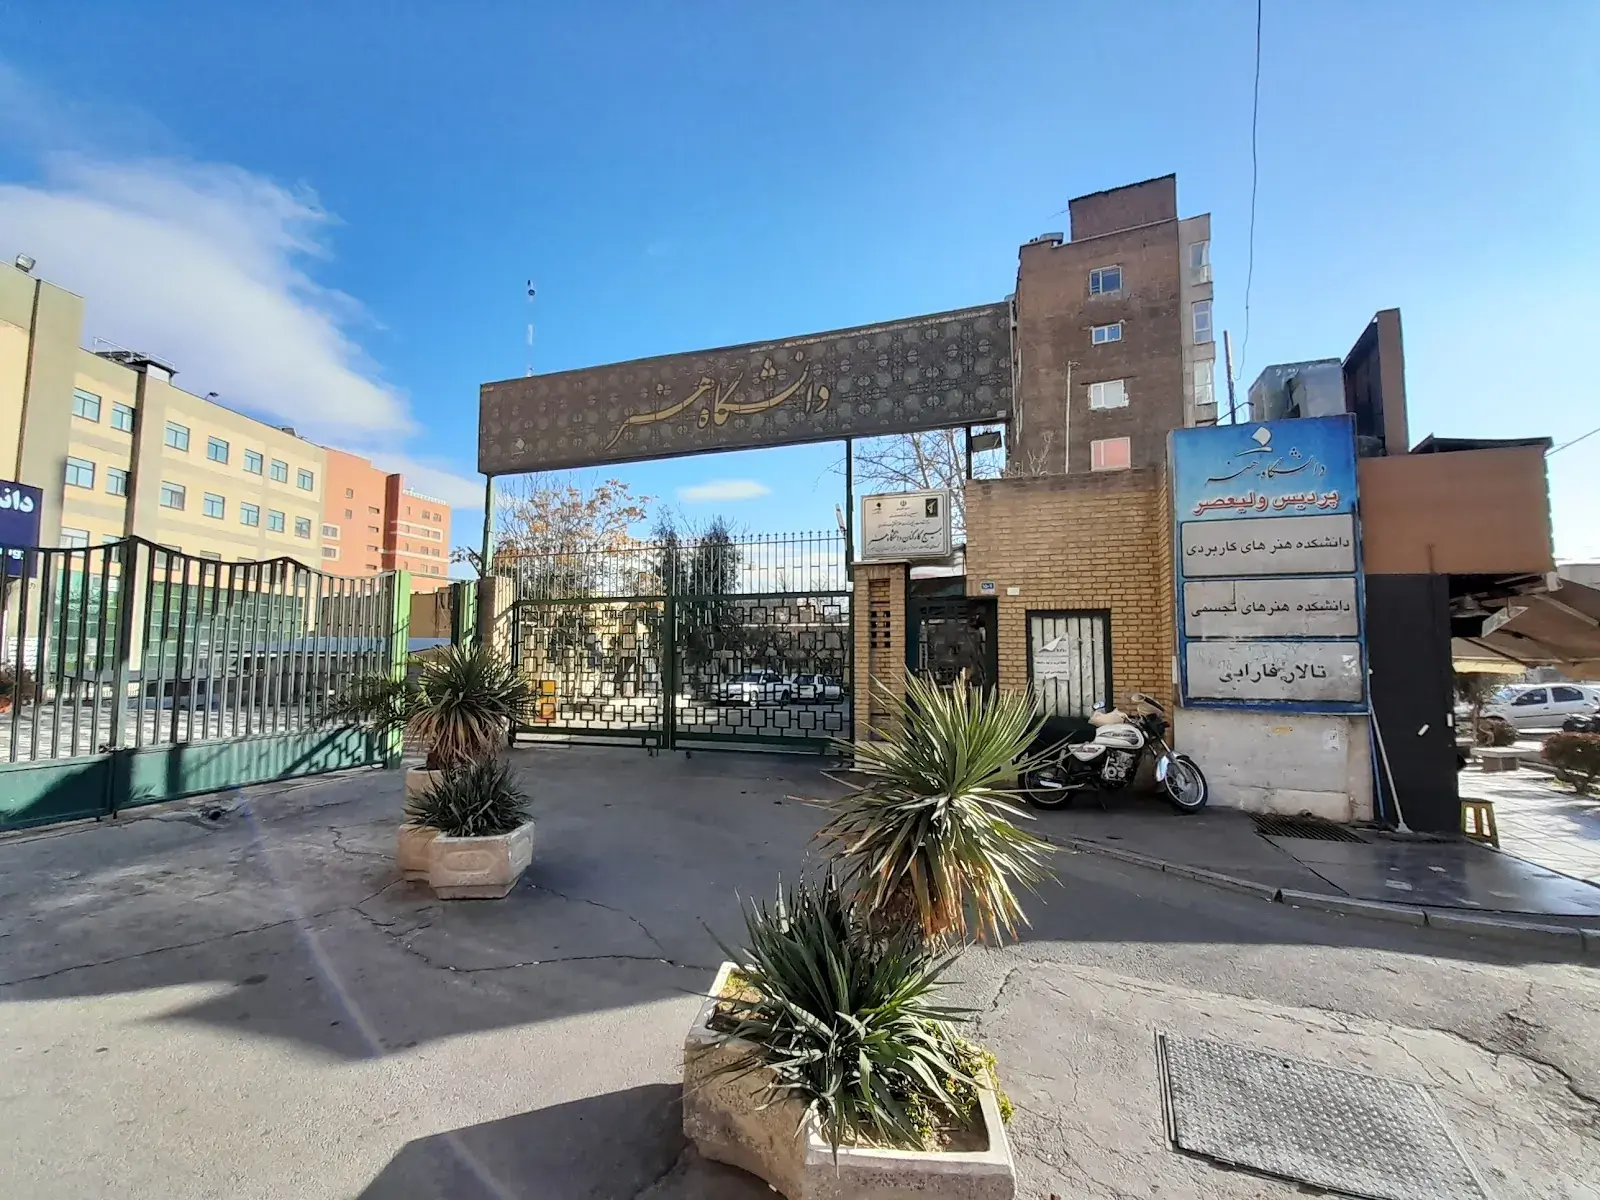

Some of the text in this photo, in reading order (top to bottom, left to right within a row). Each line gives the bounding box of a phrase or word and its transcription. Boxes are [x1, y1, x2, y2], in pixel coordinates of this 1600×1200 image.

[603, 350, 832, 451] دانشگاه هنر
[1204, 447, 1326, 486] دانشگاه هنر
[1192, 489, 1339, 516] پردیس ولیعصر
[1186, 541, 1237, 557] کاربردی
[1296, 536, 1350, 549] دانشکده
[1190, 600, 1237, 617] تجسمی
[1296, 599, 1350, 612] دانشکده
[1219, 663, 1327, 683] تالار فارابی
